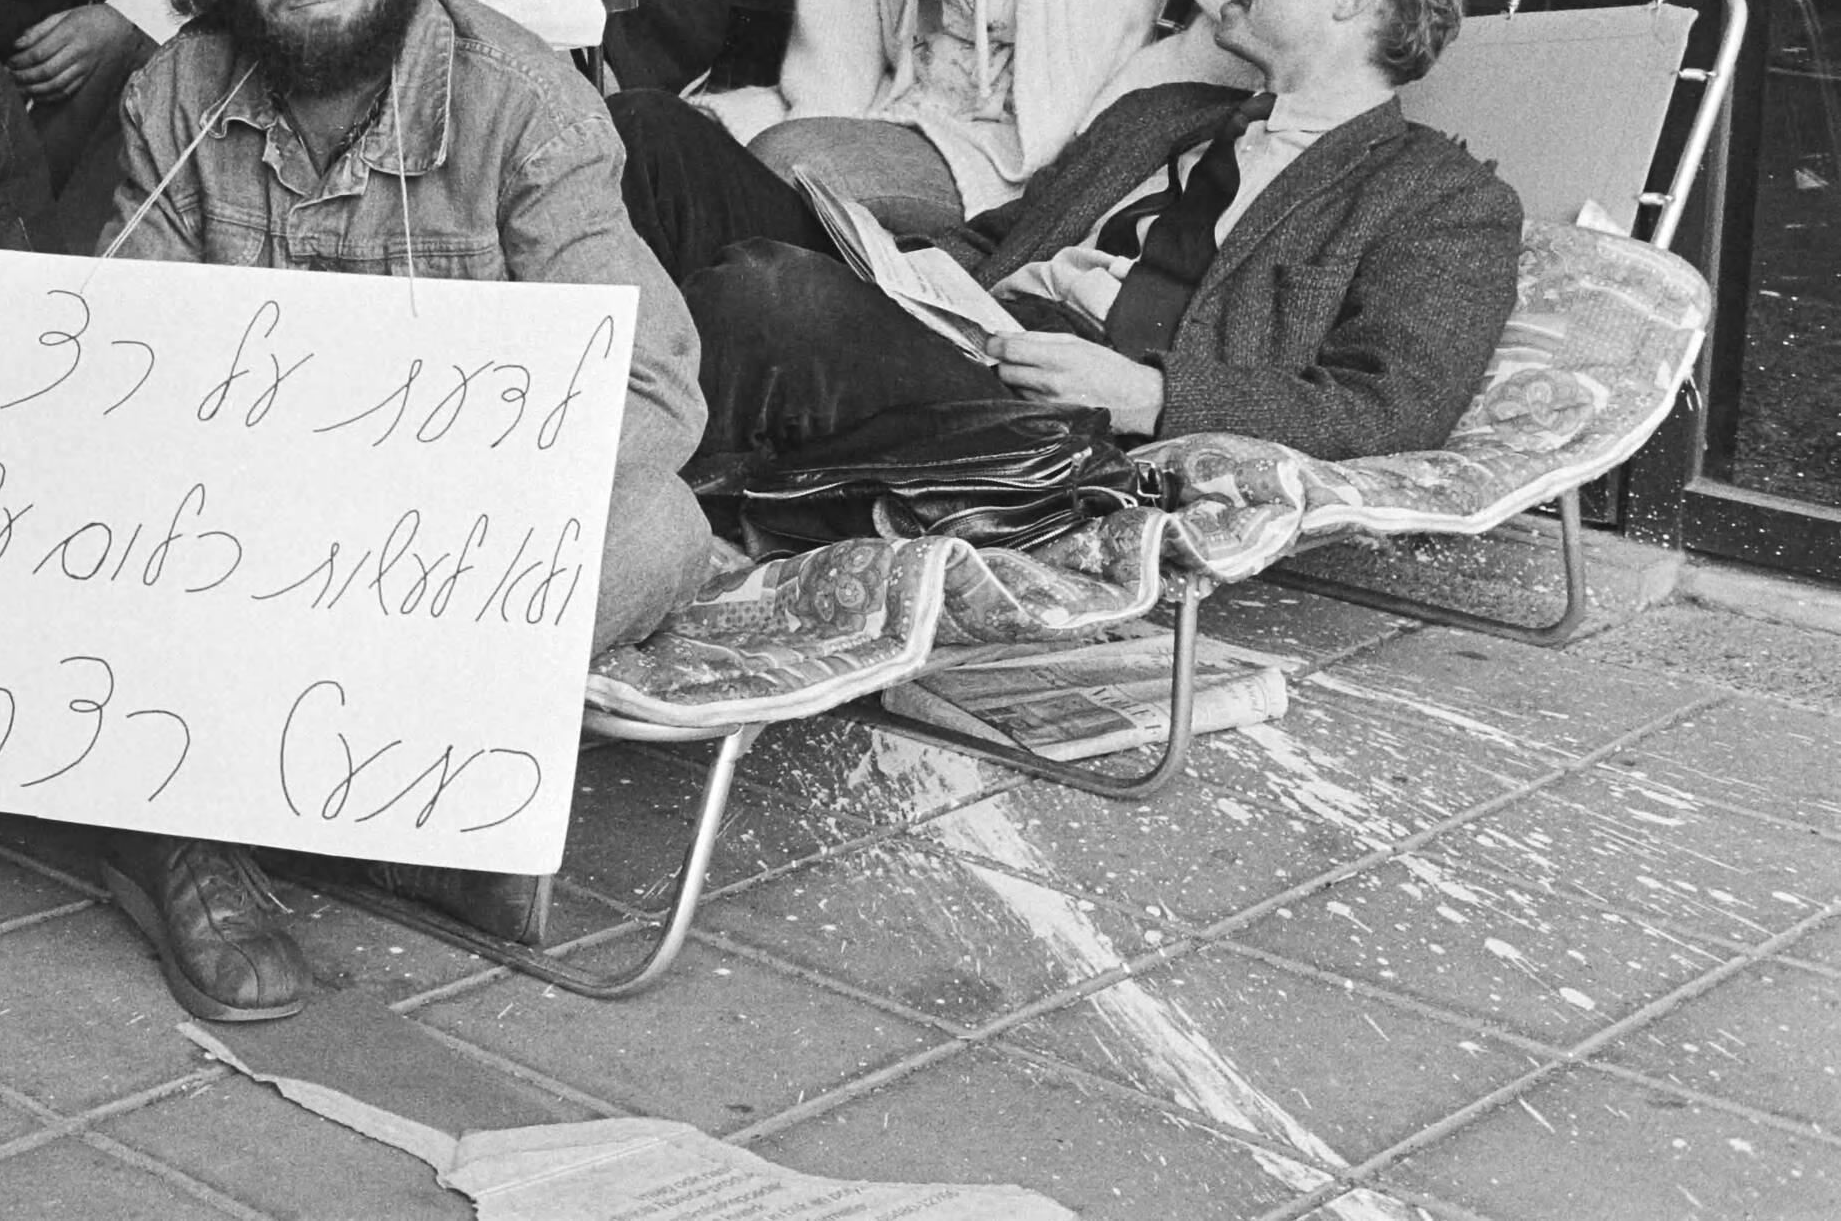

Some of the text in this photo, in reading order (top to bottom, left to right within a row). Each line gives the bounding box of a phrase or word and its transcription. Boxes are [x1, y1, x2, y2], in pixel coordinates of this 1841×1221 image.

[197, 300, 314, 427] על
[313, 315, 614, 450] לדעת
[33, 483, 242, 593] כלום
[251, 509, 490, 619] לעשות
[475, 518, 583, 626] ולא
